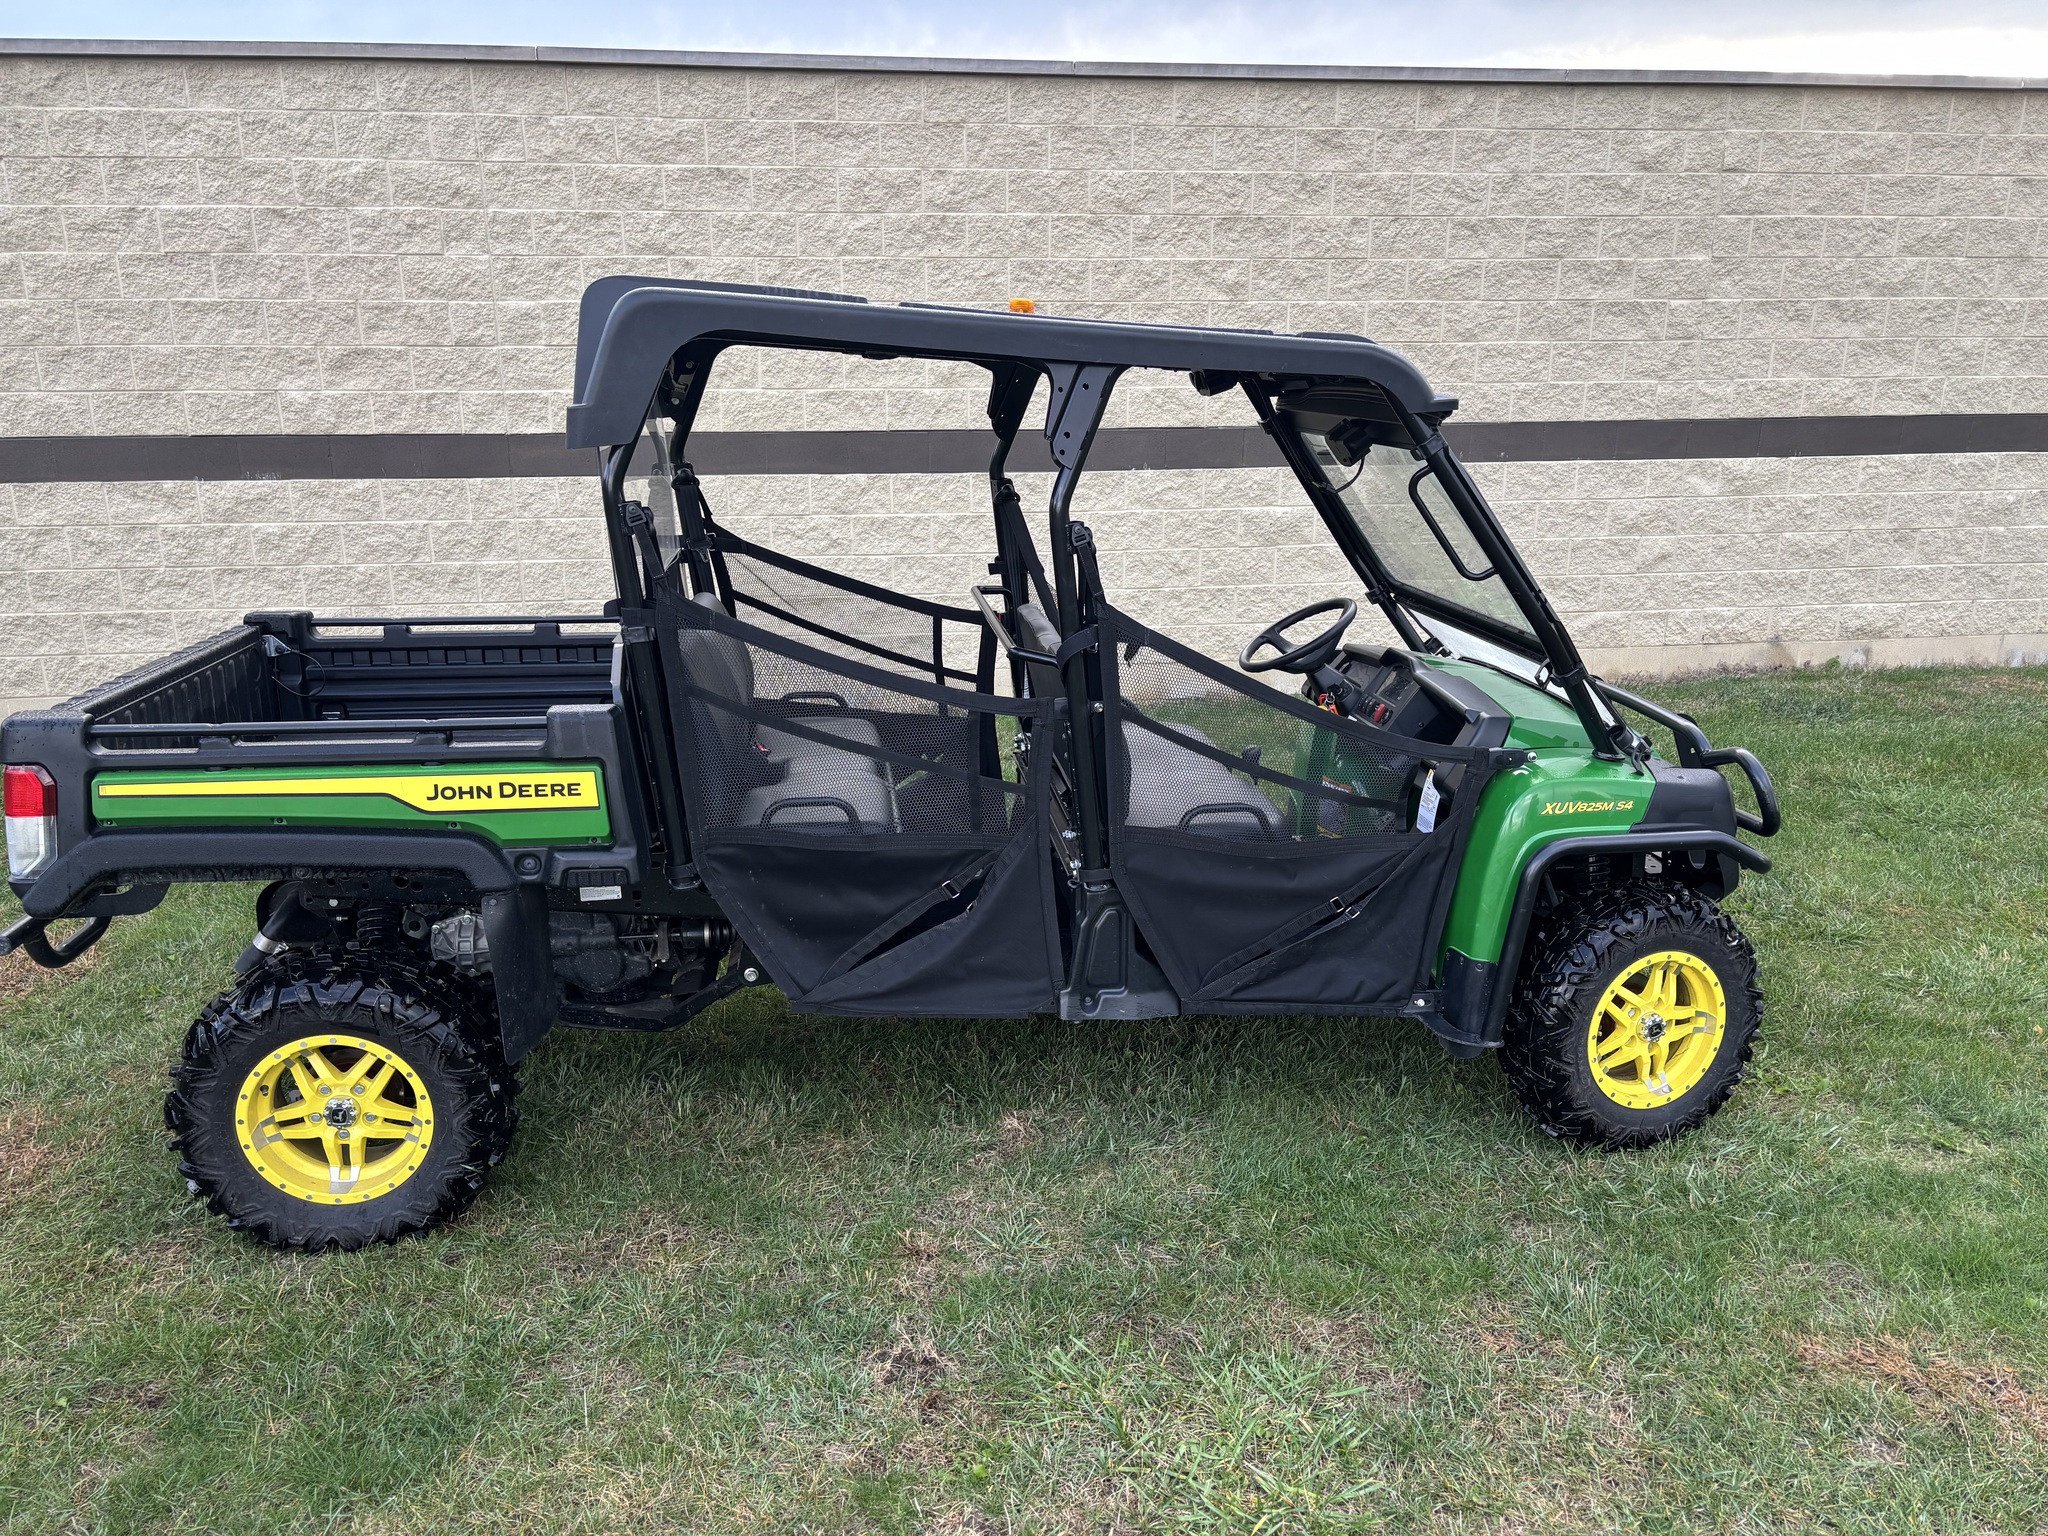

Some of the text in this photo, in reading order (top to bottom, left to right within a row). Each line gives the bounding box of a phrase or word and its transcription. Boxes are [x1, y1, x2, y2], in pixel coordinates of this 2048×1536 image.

[426, 782, 582, 801] JOHN DEERE
[1616, 801, 1635, 811] S4
